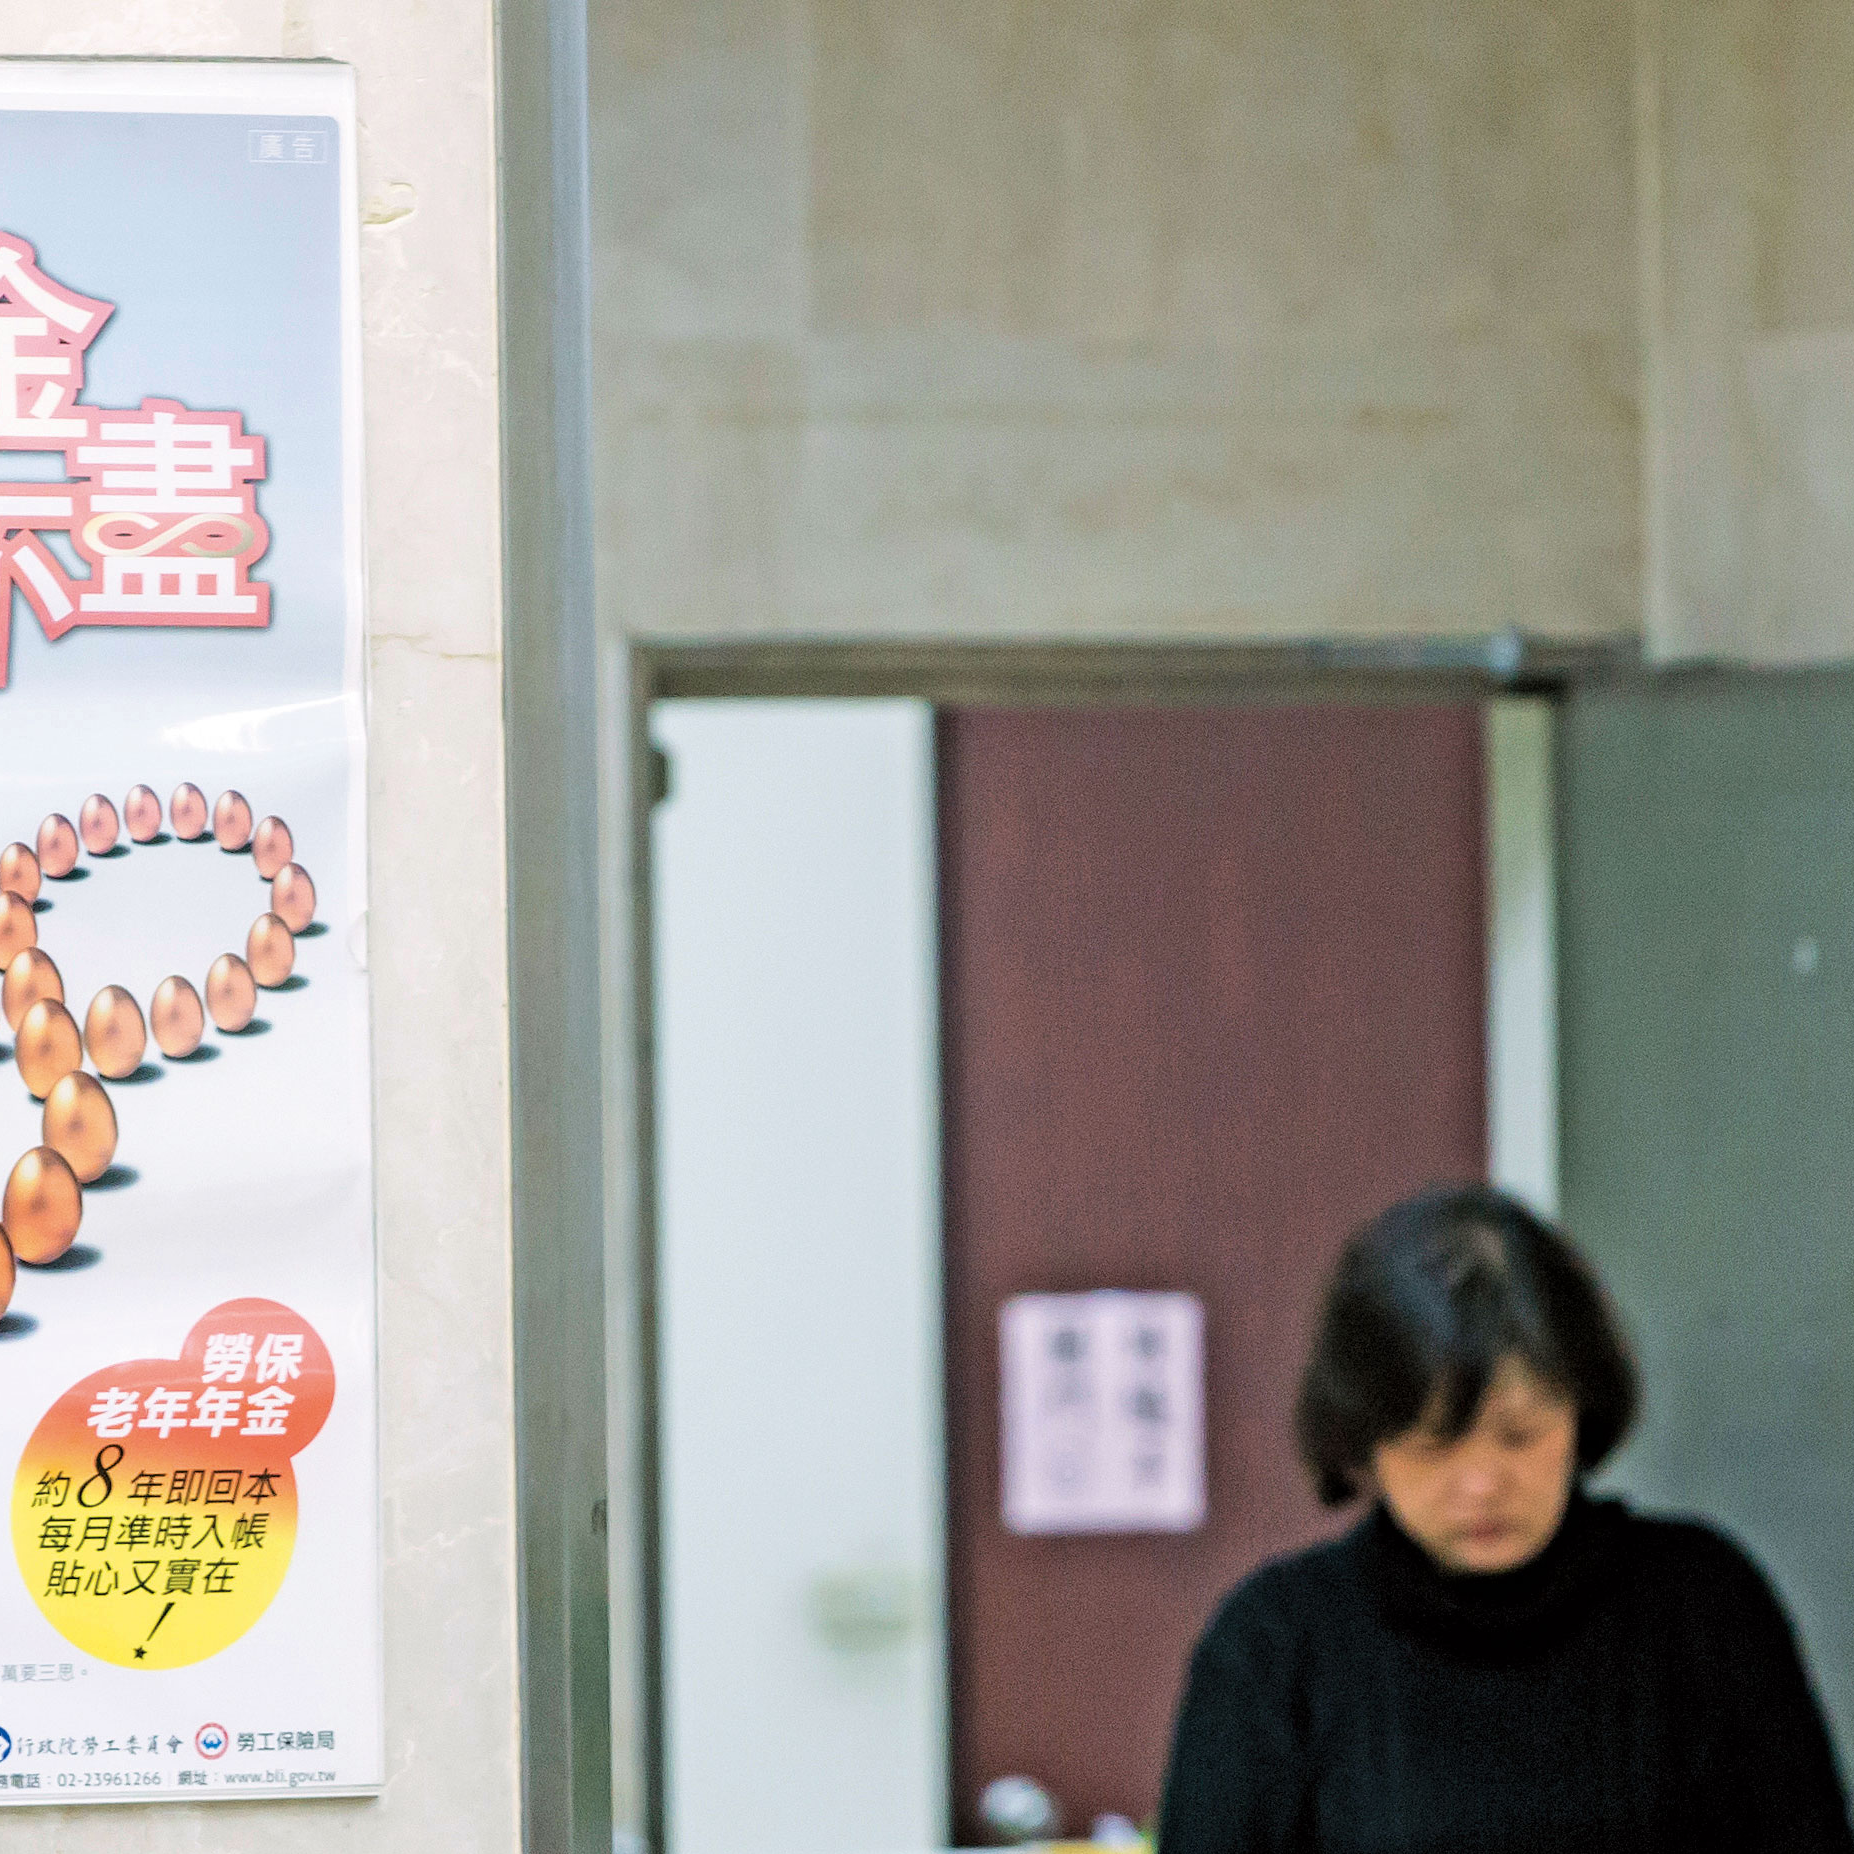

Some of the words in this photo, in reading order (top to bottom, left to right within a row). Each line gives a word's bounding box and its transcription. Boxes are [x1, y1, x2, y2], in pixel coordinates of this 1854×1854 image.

[258, 133, 316, 160] 廣告
[202, 1333, 305, 1384] 勞保
[86, 1387, 296, 1439] 老年年金
[38, 1513, 270, 1554] 每月準時入帳
[44, 1558, 240, 1598] 貼心又實在
[17, 1734, 184, 1758] 行政院勞工委員會
[237, 1729, 335, 1753] 勞工保險局
